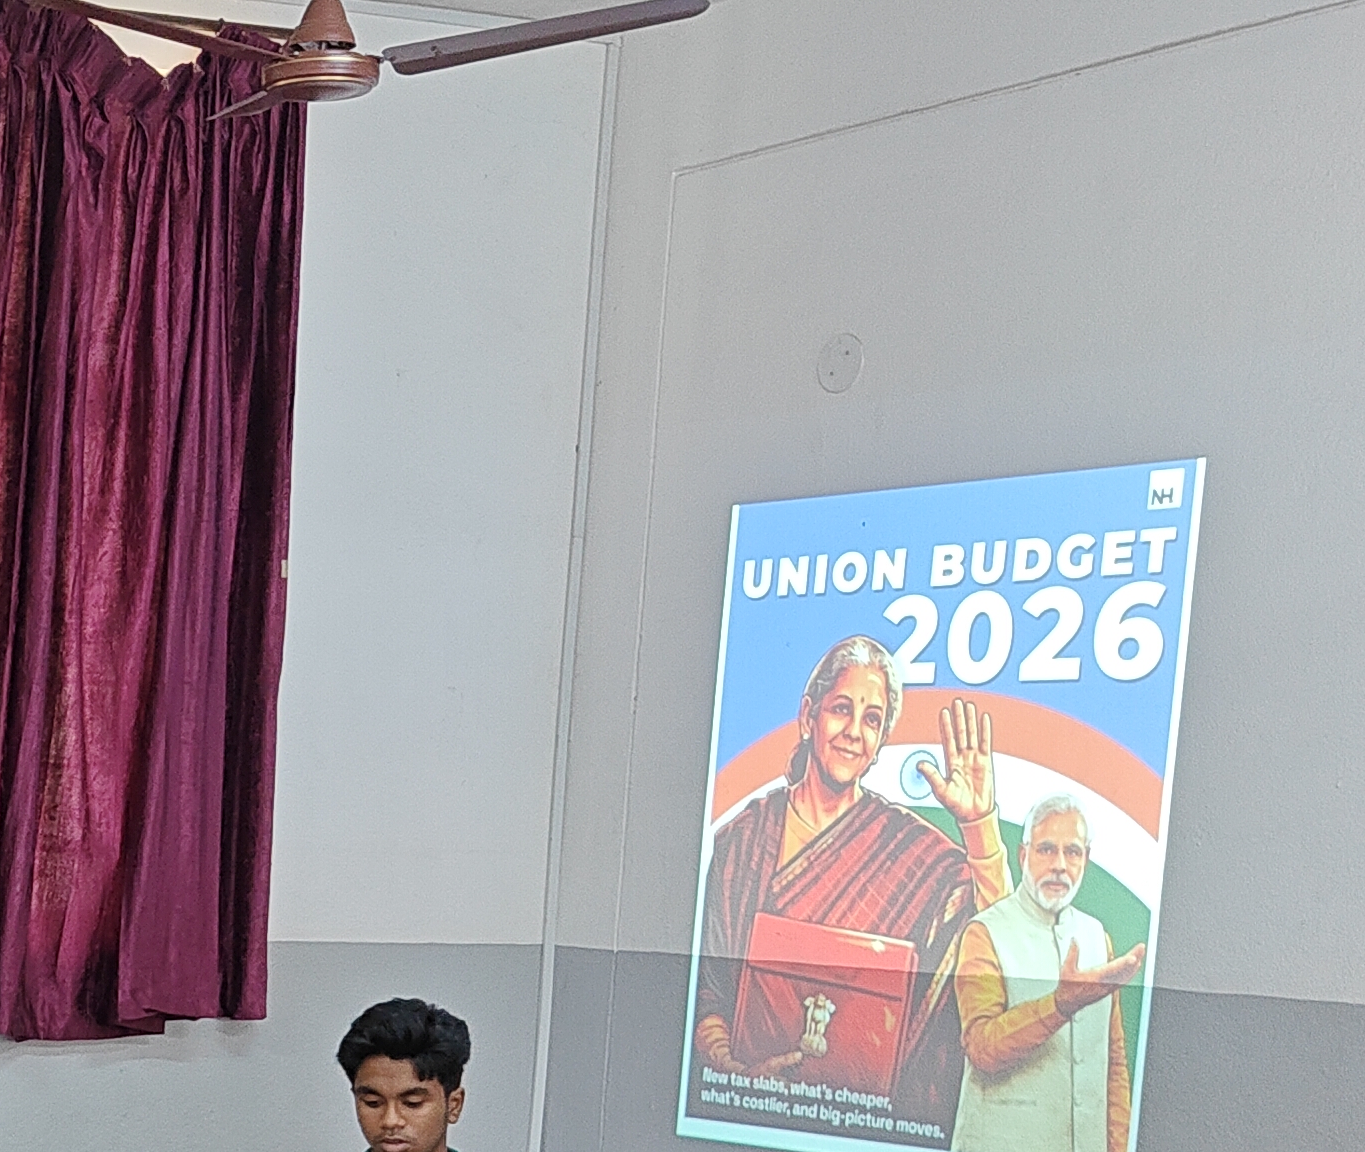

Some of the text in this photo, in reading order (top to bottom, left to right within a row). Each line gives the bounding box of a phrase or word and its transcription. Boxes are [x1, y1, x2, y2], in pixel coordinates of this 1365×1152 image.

[742, 526, 1177, 599] UNION BUDGET
[882, 580, 1167, 685] 2026
[701, 1089, 945, 1139] what's costlier, and big-picture moves.
[702, 1067, 893, 1112] New tax slabs, what's cheaper,
